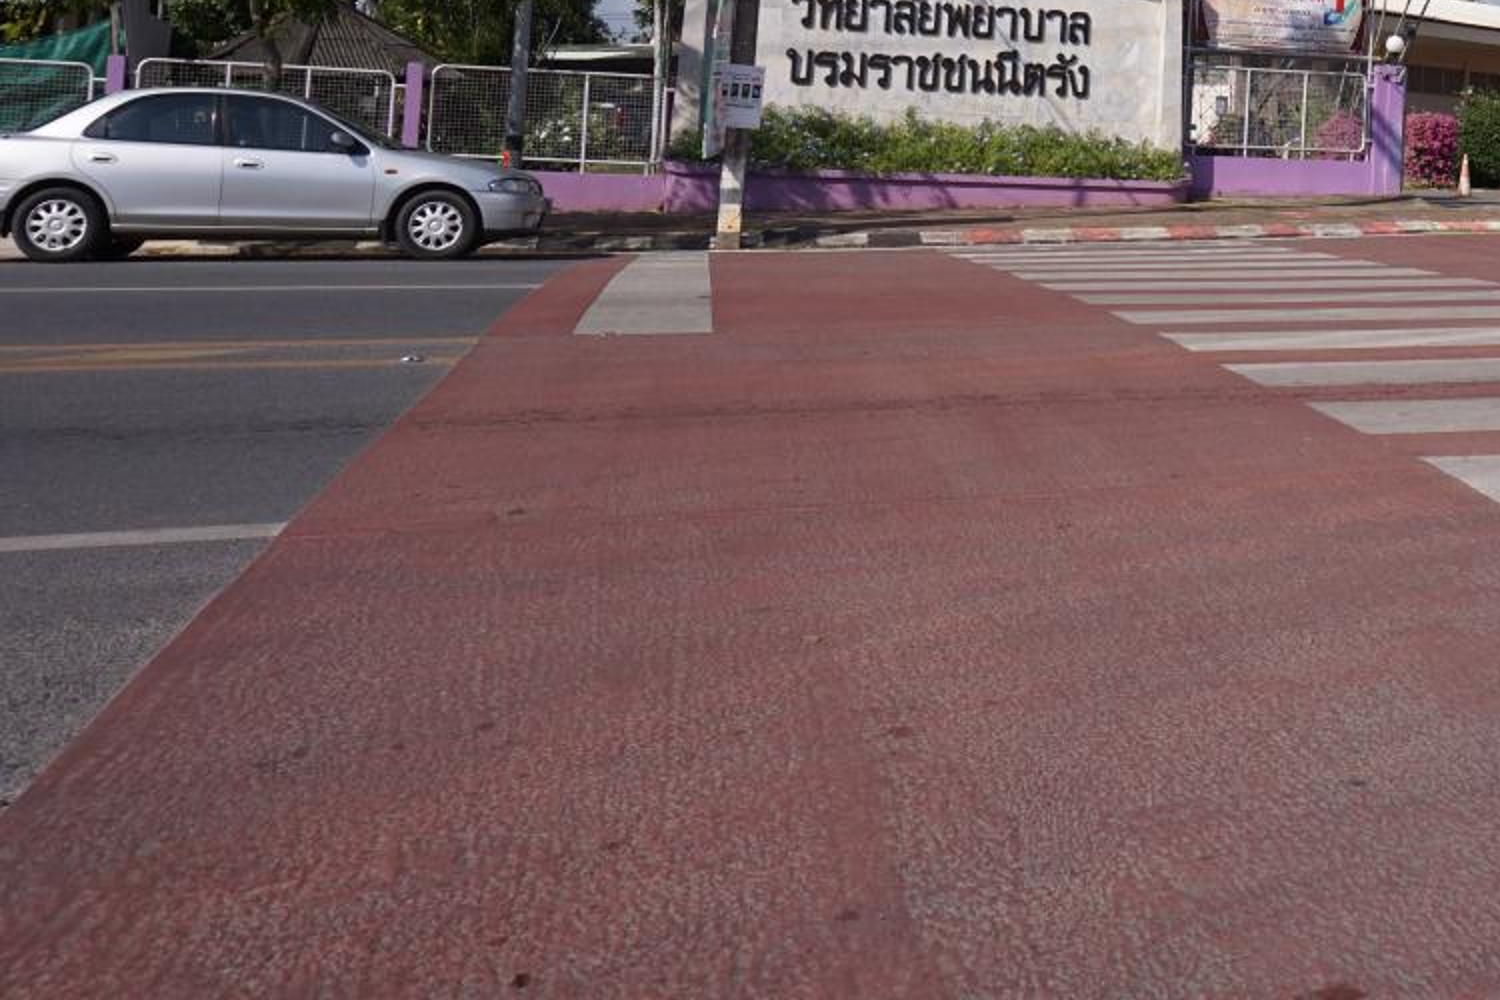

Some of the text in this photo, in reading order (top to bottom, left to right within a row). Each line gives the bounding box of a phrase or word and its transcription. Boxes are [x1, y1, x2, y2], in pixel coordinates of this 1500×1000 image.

[786, 47, 1091, 99] บรมราชชนนีตรัง
